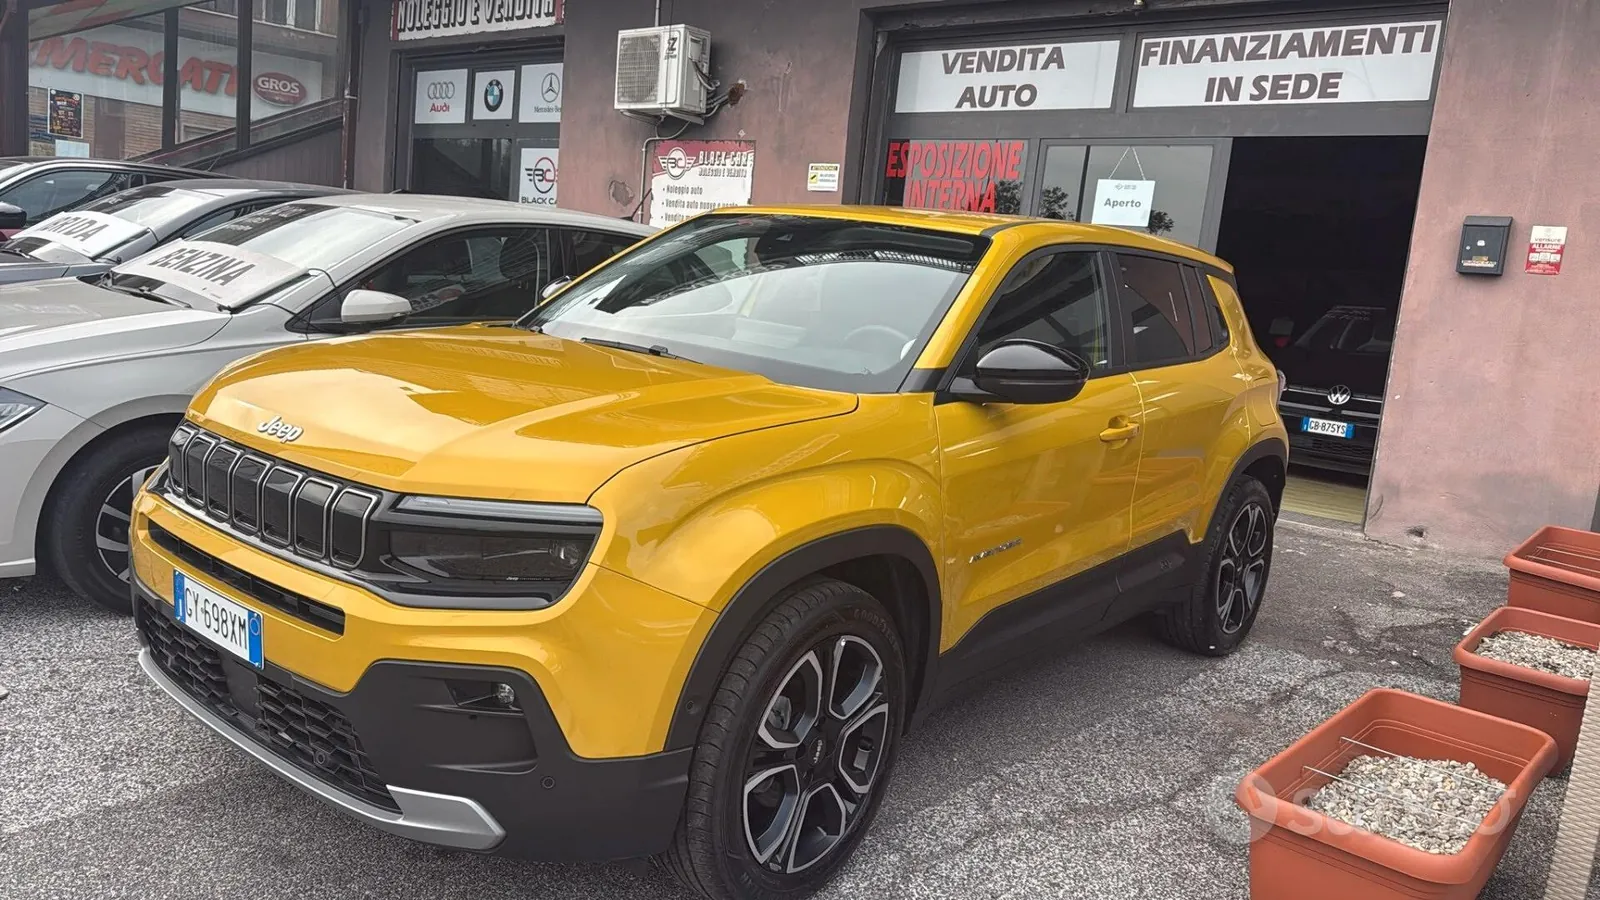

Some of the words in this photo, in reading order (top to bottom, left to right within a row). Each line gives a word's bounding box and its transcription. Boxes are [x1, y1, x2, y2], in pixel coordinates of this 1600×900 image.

[1141, 24, 1436, 66] FINANZIAMENTI
[30, 36, 238, 97] MERCATI
[942, 47, 1065, 75] VENDITA
[257, 76, 300, 94] GROS
[955, 84, 1038, 109] AUTO
[1205, 76, 1242, 103] IN
[1249, 72, 1343, 101] SEDE
[429, 102, 450, 113] Audi
[886, 141, 1024, 179] ESPOSIZIONE
[521, 196, 547, 205] BLACK
[903, 179, 997, 214] INTERNA
[1104, 198, 1142, 209] Aperto
[148, 247, 256, 286] BENZINA
[256, 415, 304, 444] Jeep
